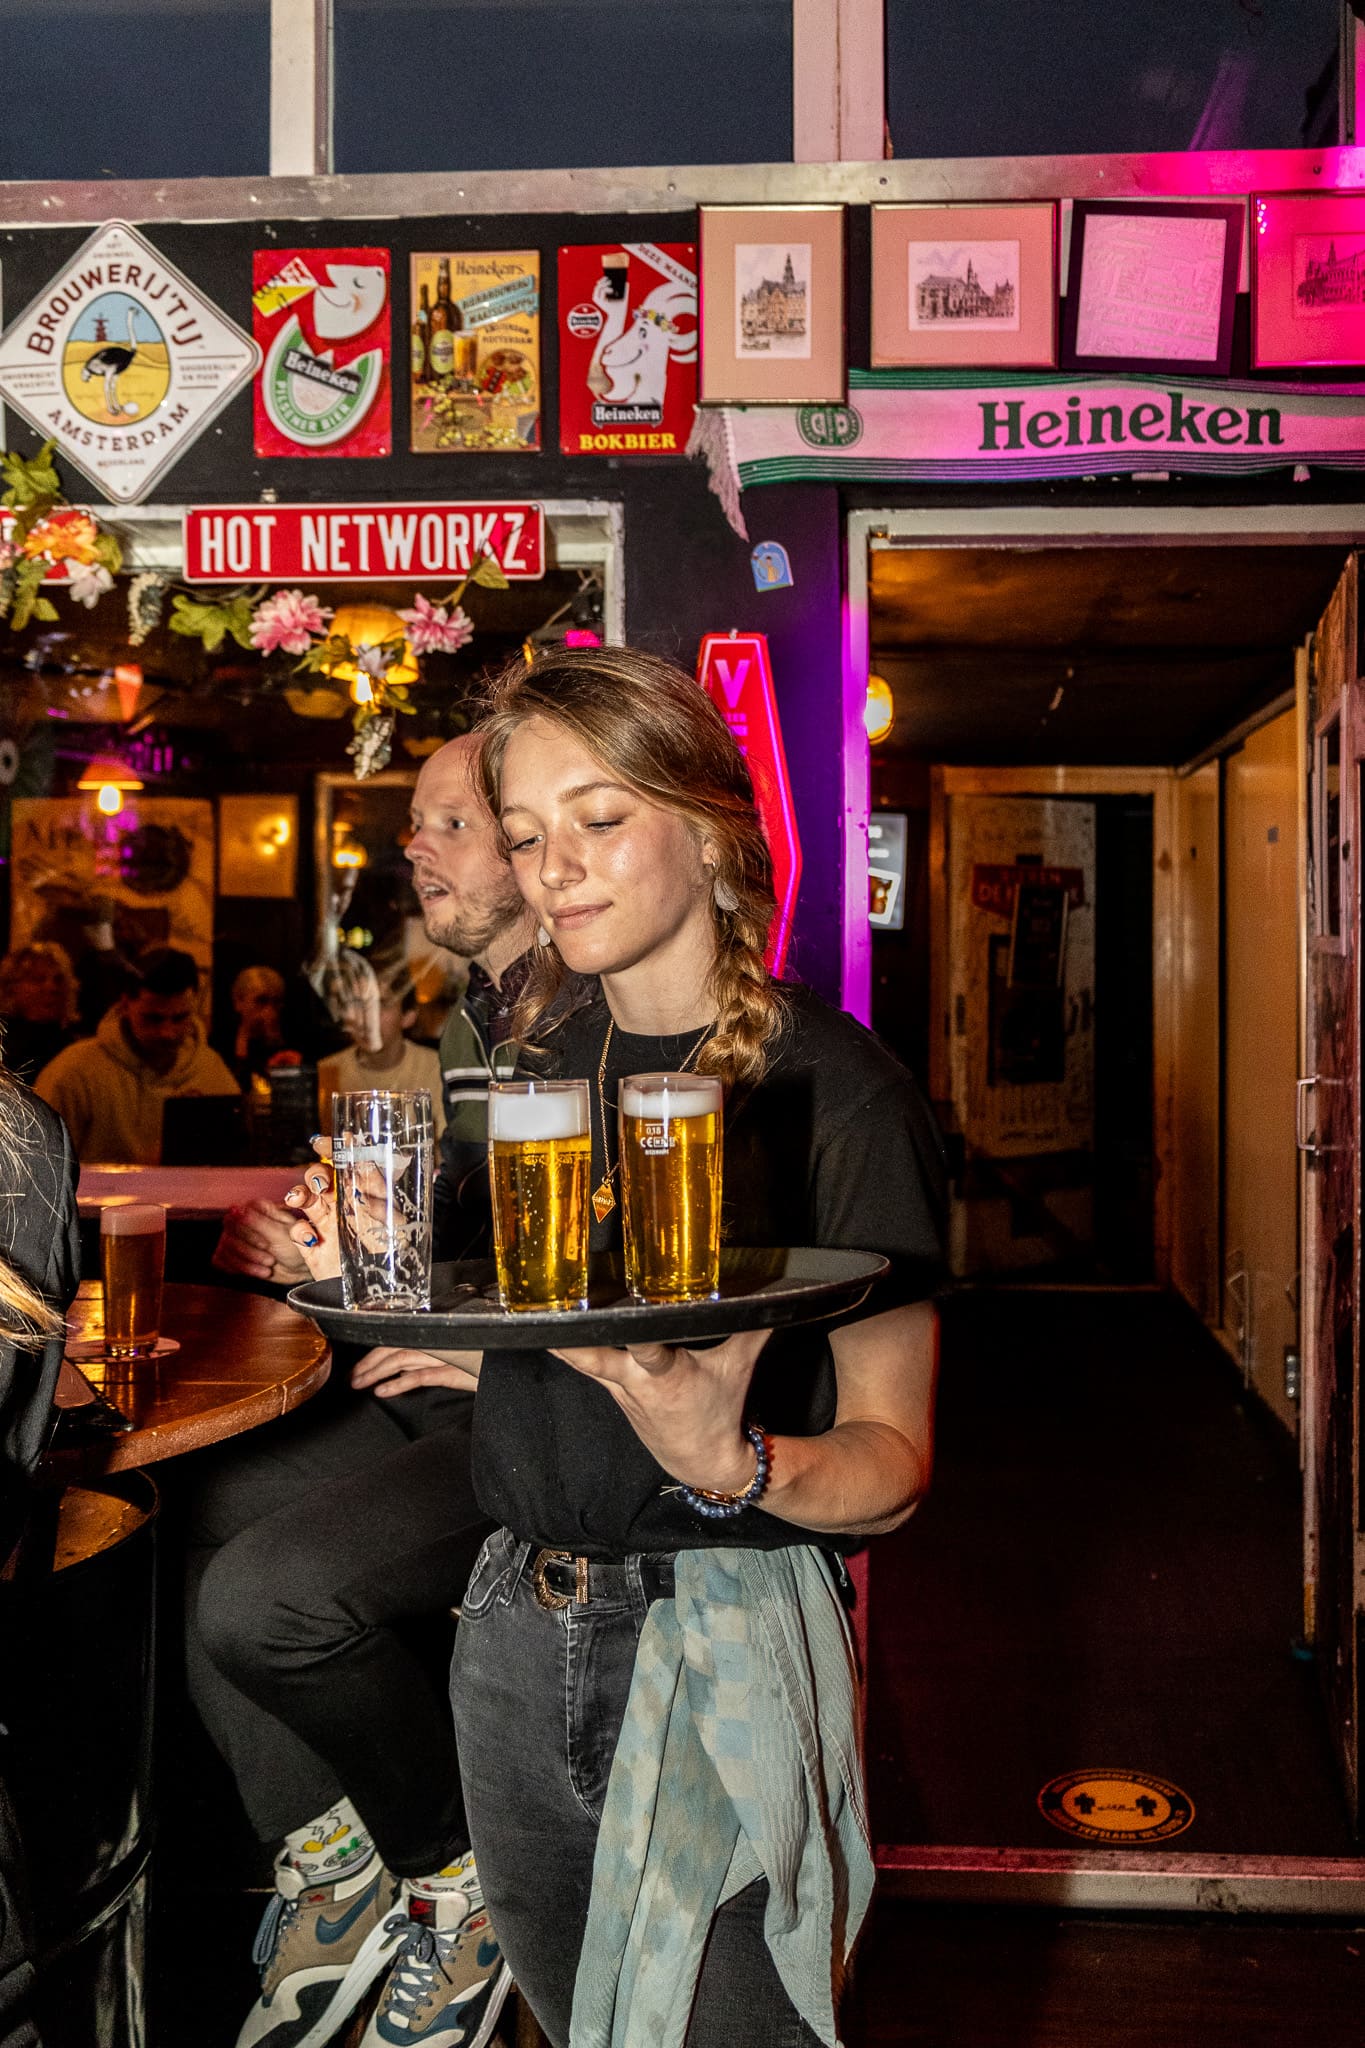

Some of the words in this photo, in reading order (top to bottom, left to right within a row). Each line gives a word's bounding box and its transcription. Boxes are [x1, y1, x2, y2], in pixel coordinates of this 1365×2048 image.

[284, 350, 359, 392] Heineken
[47, 403, 190, 451] AMSTERDAM
[595, 405, 660, 421] Heineken
[977, 391, 1285, 451] Heineken
[579, 433, 677, 450] BOKBIER
[200, 515, 278, 573] HOT
[300, 512, 528, 573] NETWORKZ
